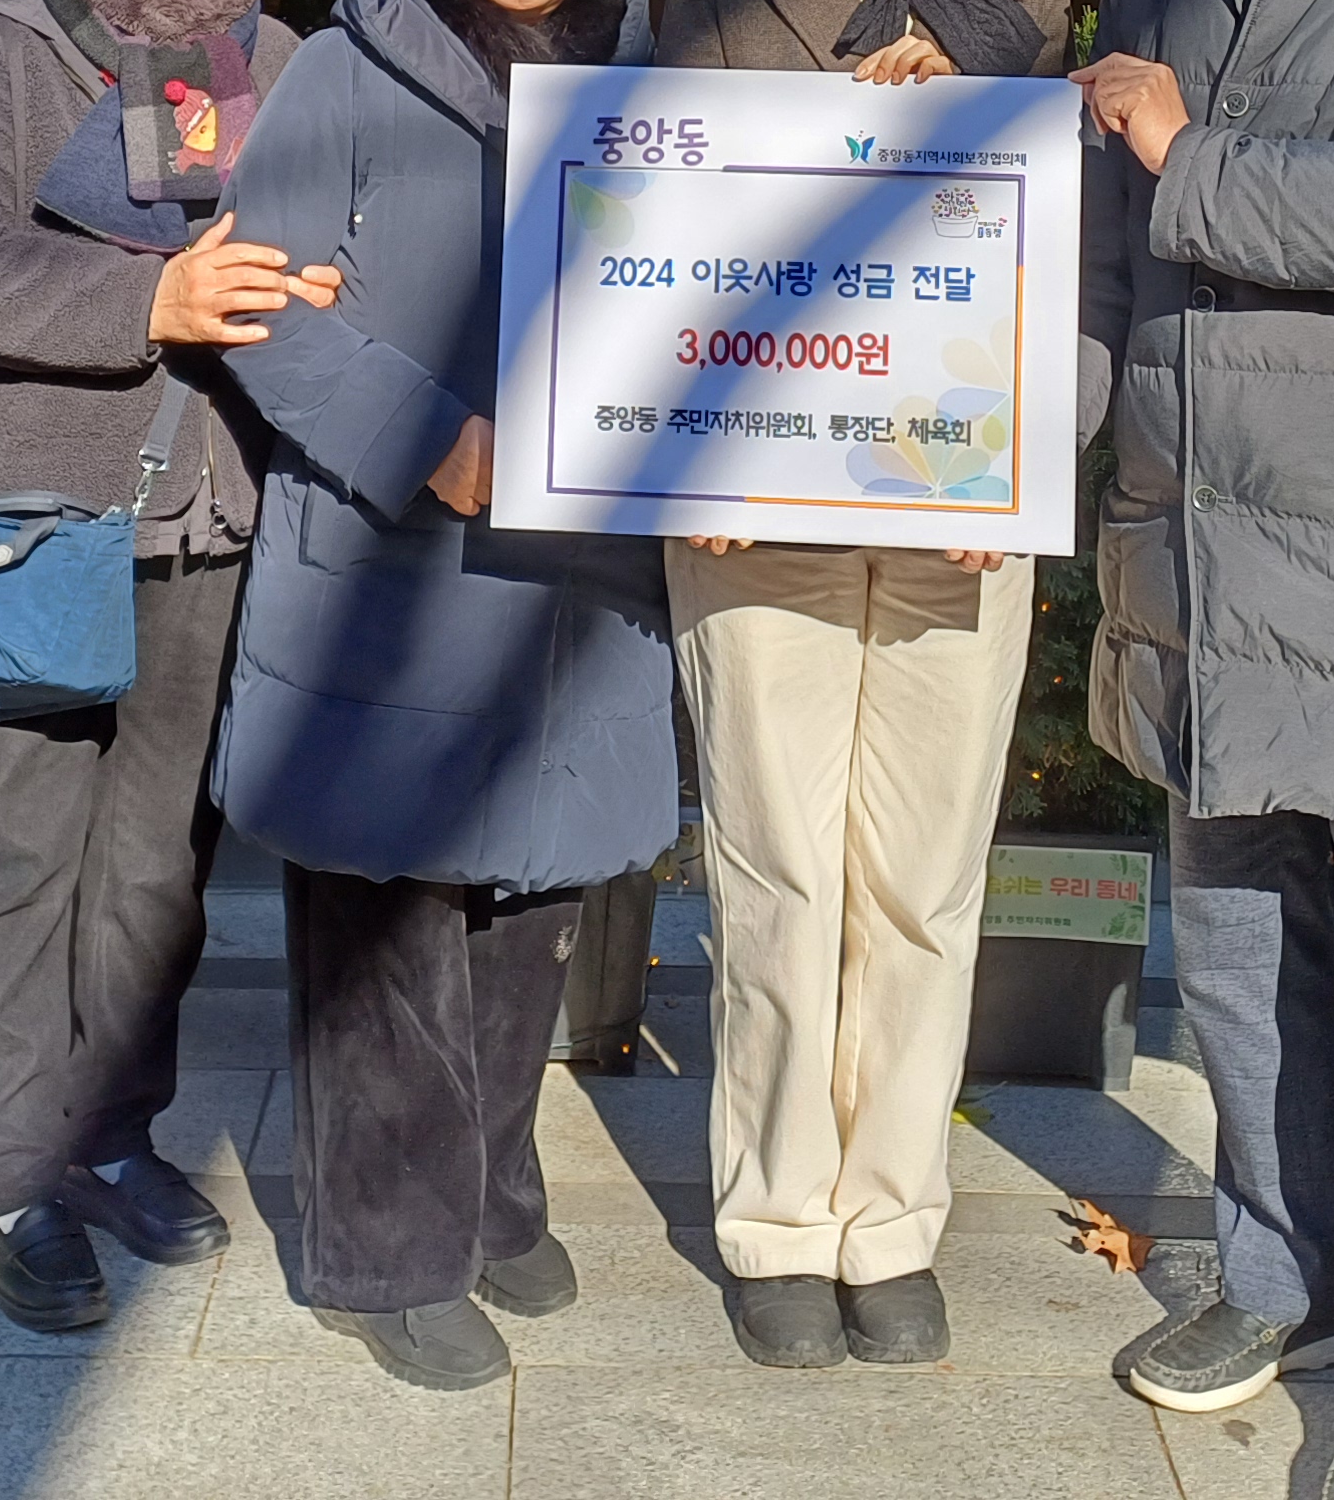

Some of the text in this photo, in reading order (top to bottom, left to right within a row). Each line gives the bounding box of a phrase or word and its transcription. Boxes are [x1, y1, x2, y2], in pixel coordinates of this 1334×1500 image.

[592, 116, 710, 166] 중앙동
[876, 147, 1028, 168] 중앙동지역사회보장협의체
[598, 256, 977, 303] 2024 이웃사랑 성금 전달
[675, 328, 891, 377] 3,000,000원
[593, 404, 972, 447] 중앙동 주민자치위원회, 통장단, 체육회
[1049, 877, 1091, 897] 우리
[1096, 879, 1139, 902] 동네
